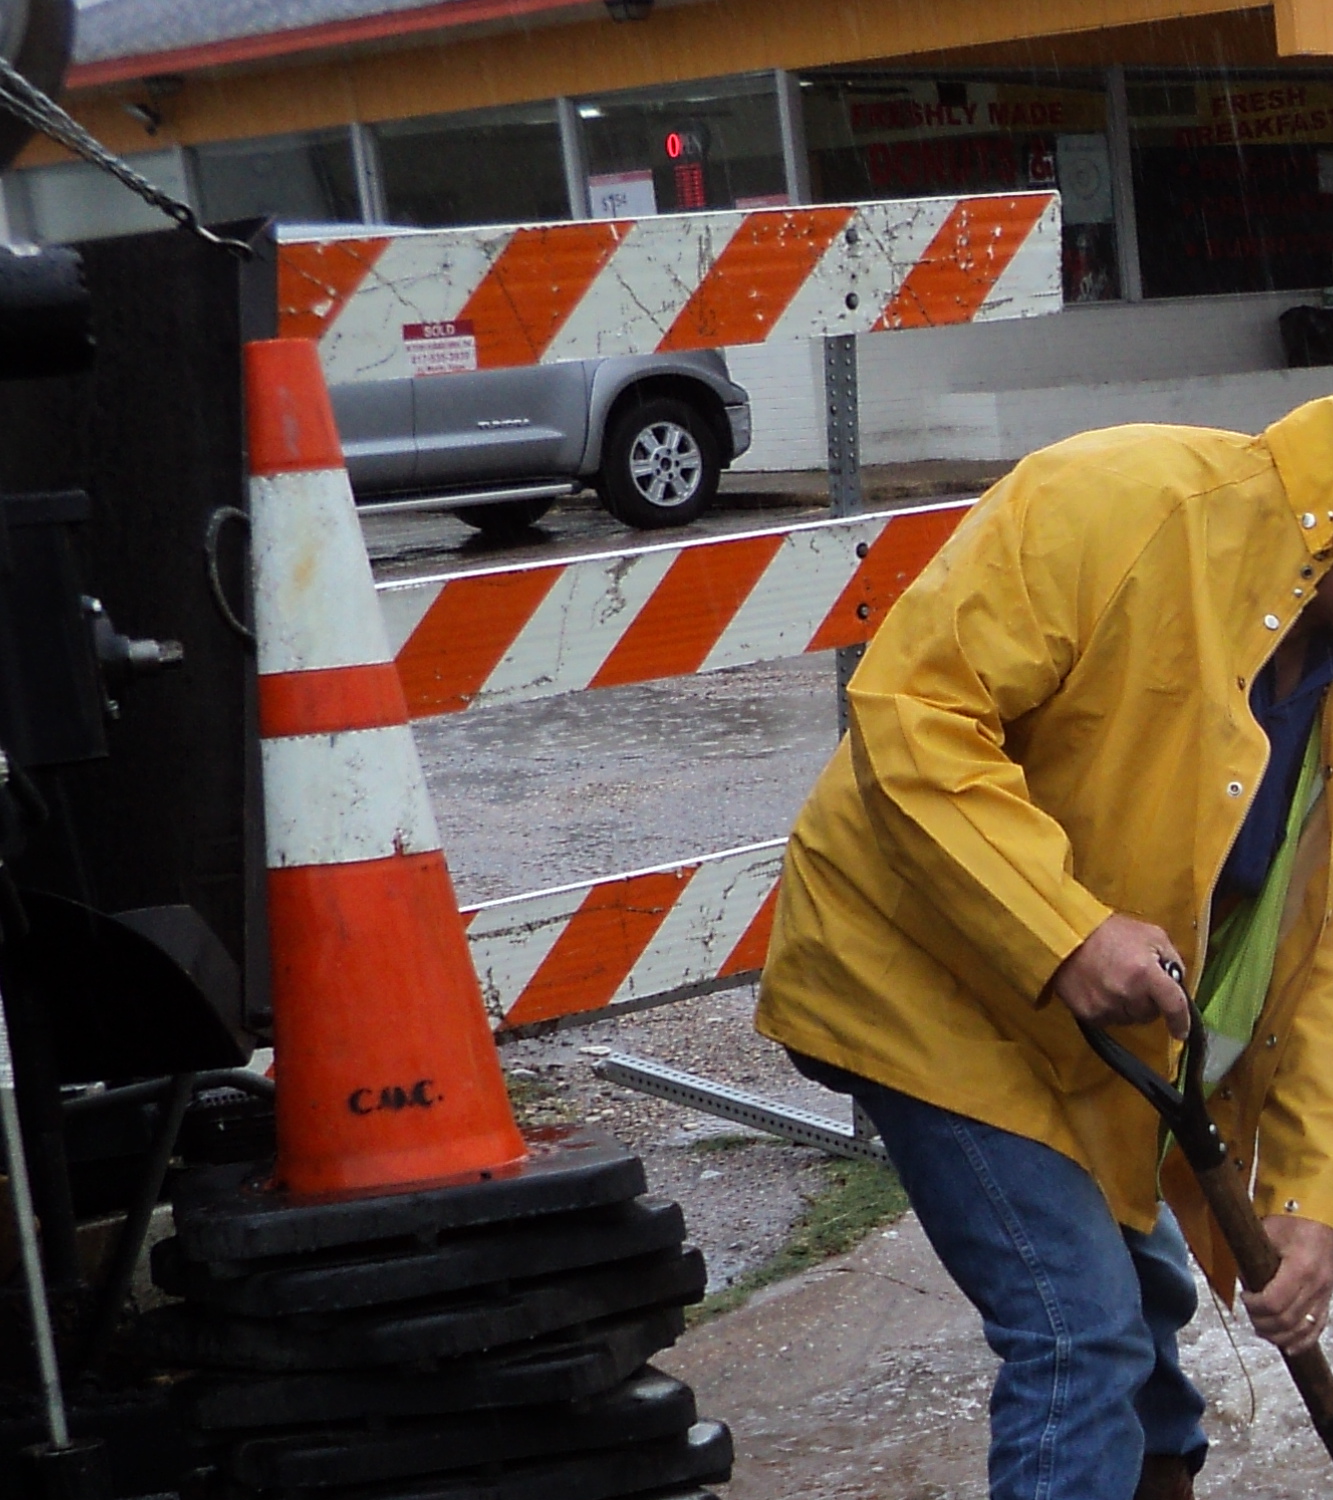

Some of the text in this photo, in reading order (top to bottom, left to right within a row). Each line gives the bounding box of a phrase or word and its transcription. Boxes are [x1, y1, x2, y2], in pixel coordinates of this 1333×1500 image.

[851, 102, 1062, 127] FRESHLY MADE
[1210, 87, 1307, 117] FRESH
[869, 139, 1018, 186] DONUTS
[424, 324, 455, 338] SOLD
